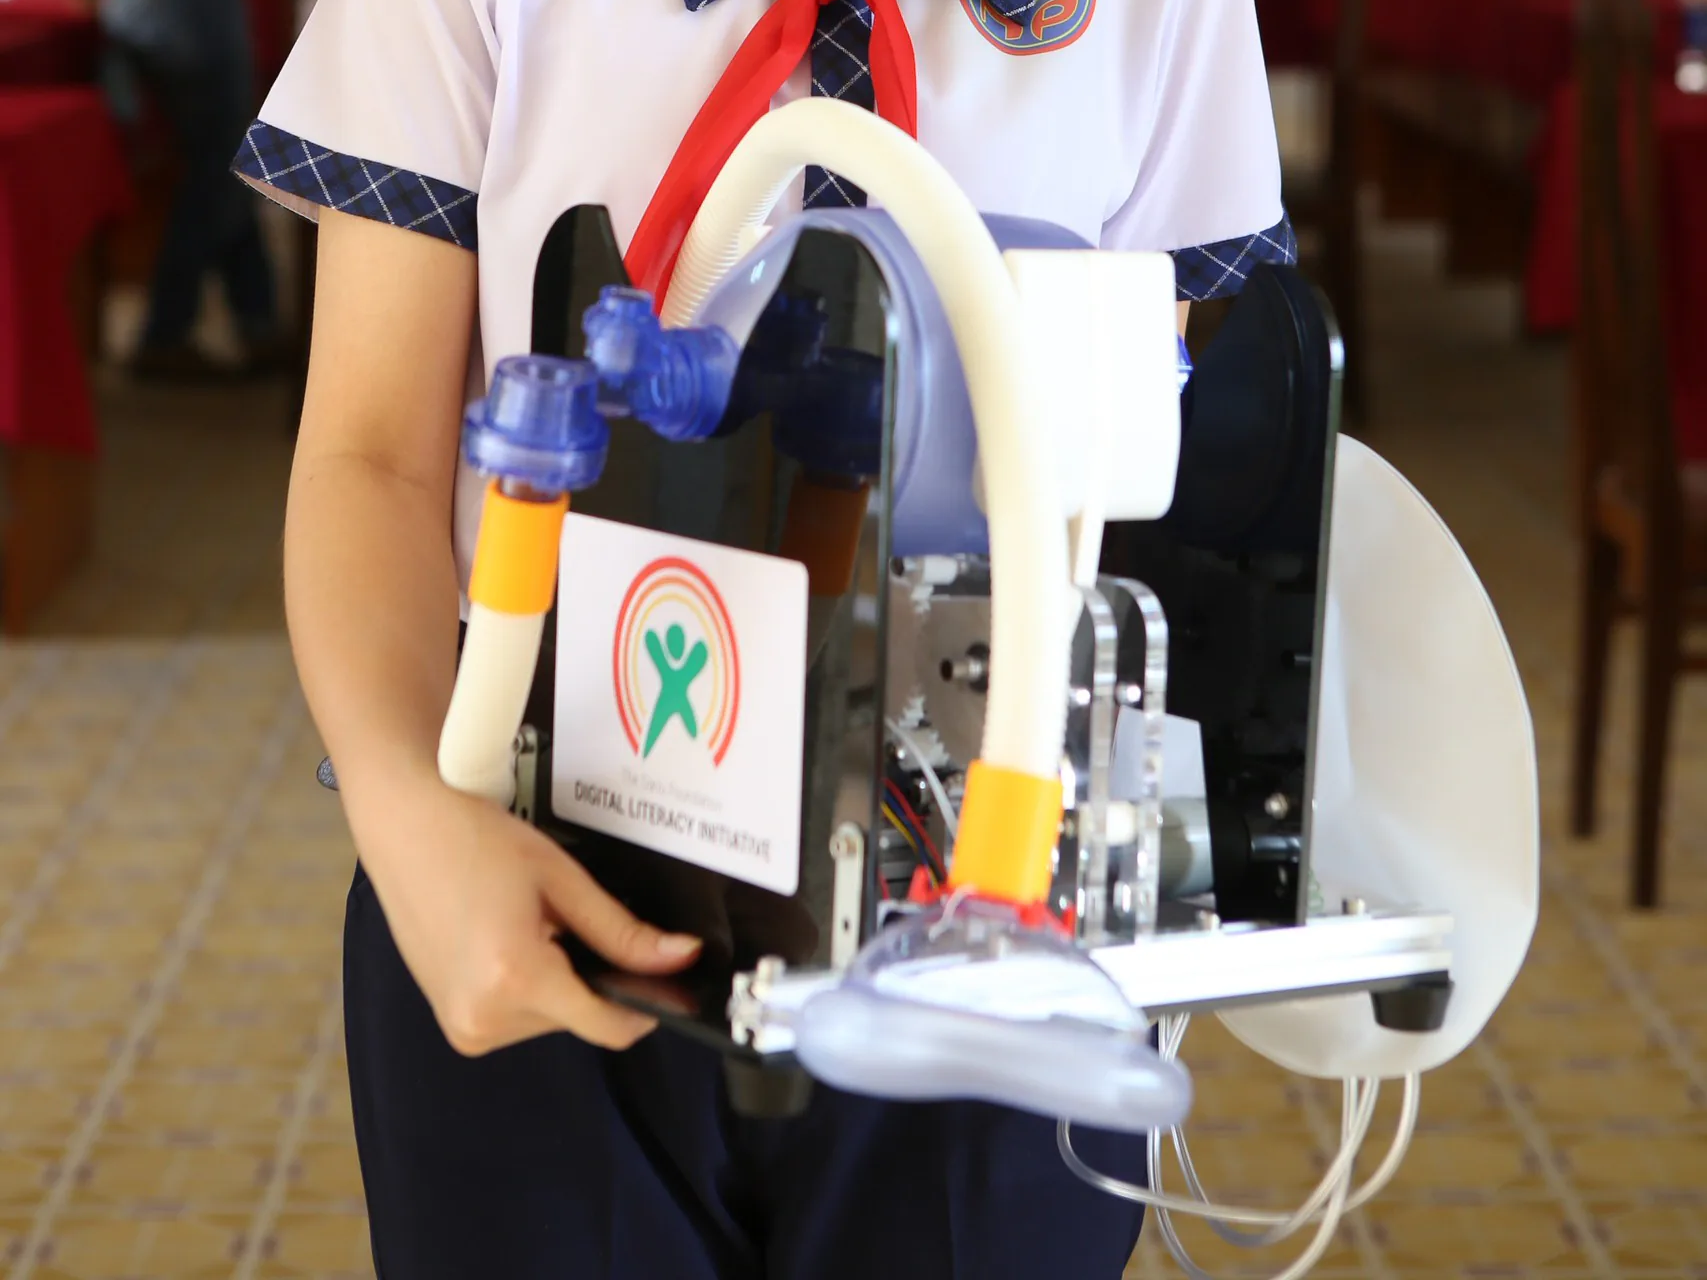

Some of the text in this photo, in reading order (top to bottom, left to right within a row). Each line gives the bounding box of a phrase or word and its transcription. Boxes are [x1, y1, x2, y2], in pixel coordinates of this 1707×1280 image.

[574, 779, 625, 815] DIGITAL
[627, 796, 695, 837] LITERACY
[697, 819, 772, 863] INITIATIVE
